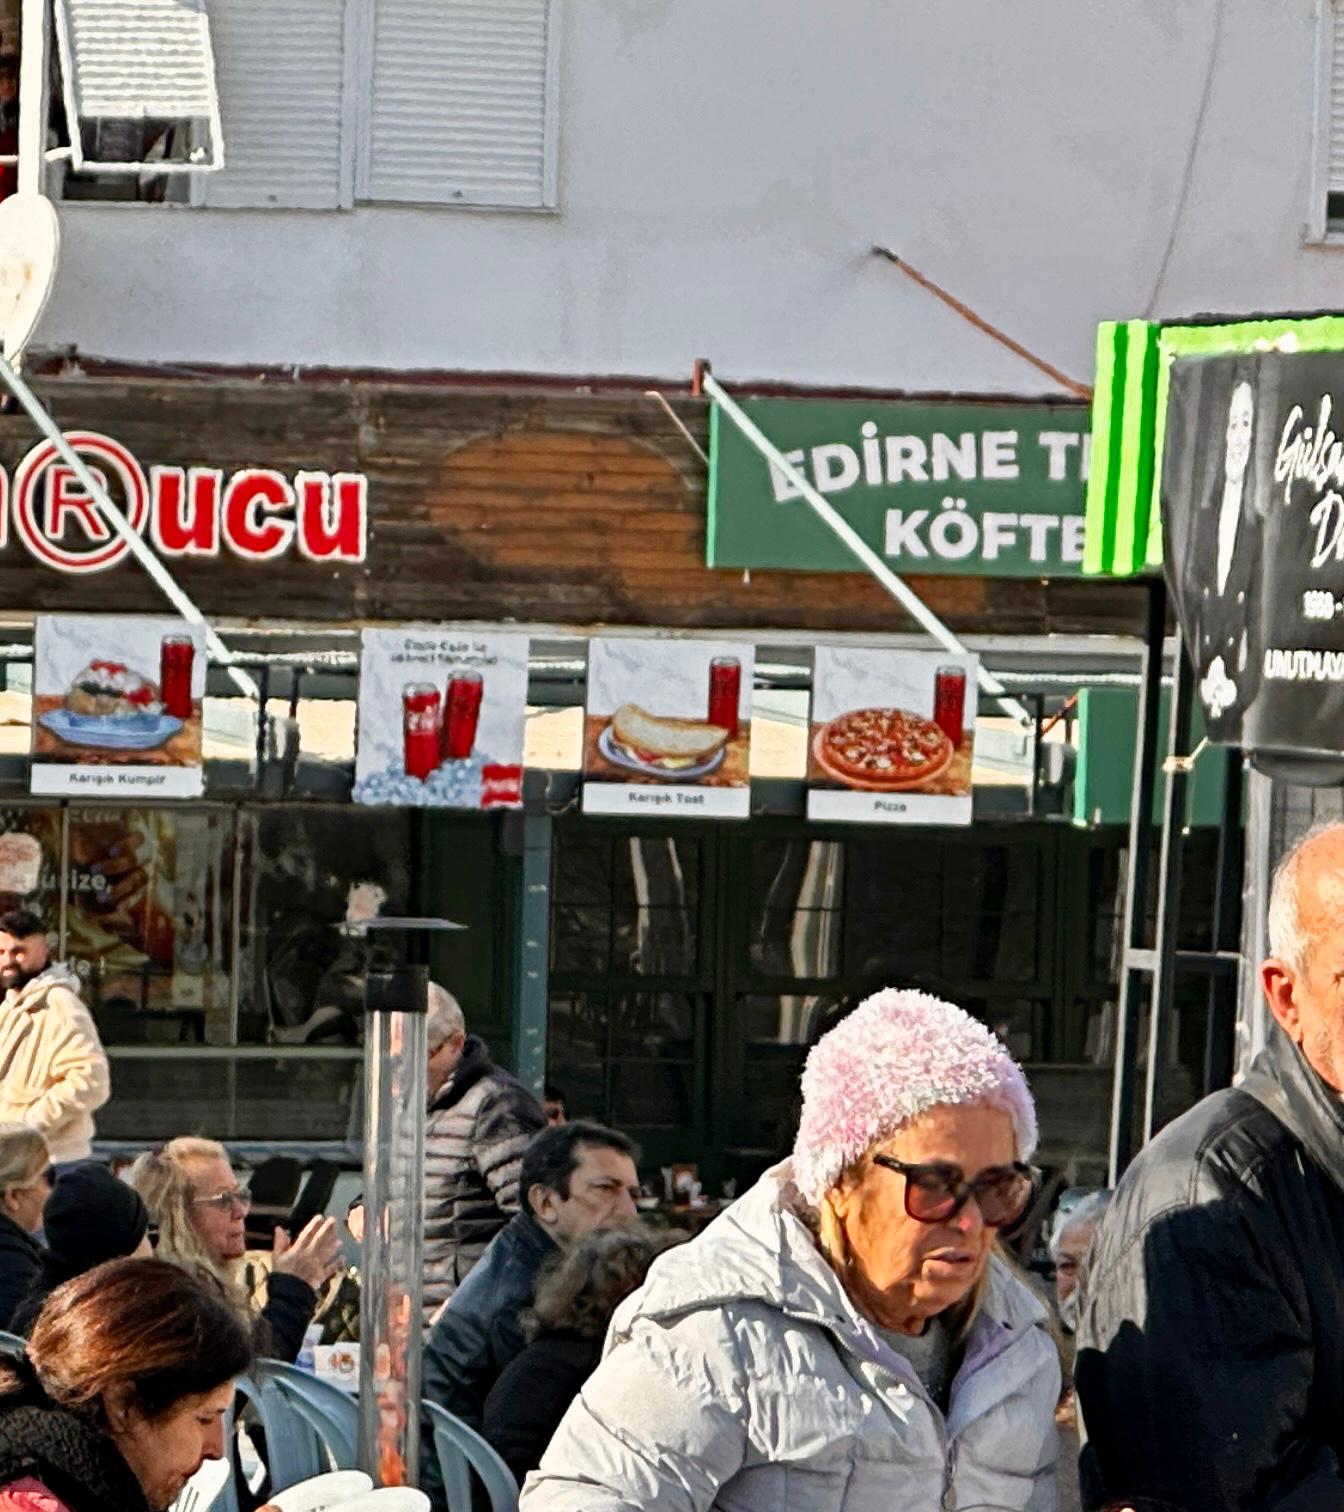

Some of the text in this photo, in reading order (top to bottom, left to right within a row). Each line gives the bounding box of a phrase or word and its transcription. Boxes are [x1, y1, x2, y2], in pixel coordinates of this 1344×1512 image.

[768, 420, 1092, 503] EDİRNE T
[118, 774, 166, 786] Kumpir
[873, 800, 907, 813] Pizza
